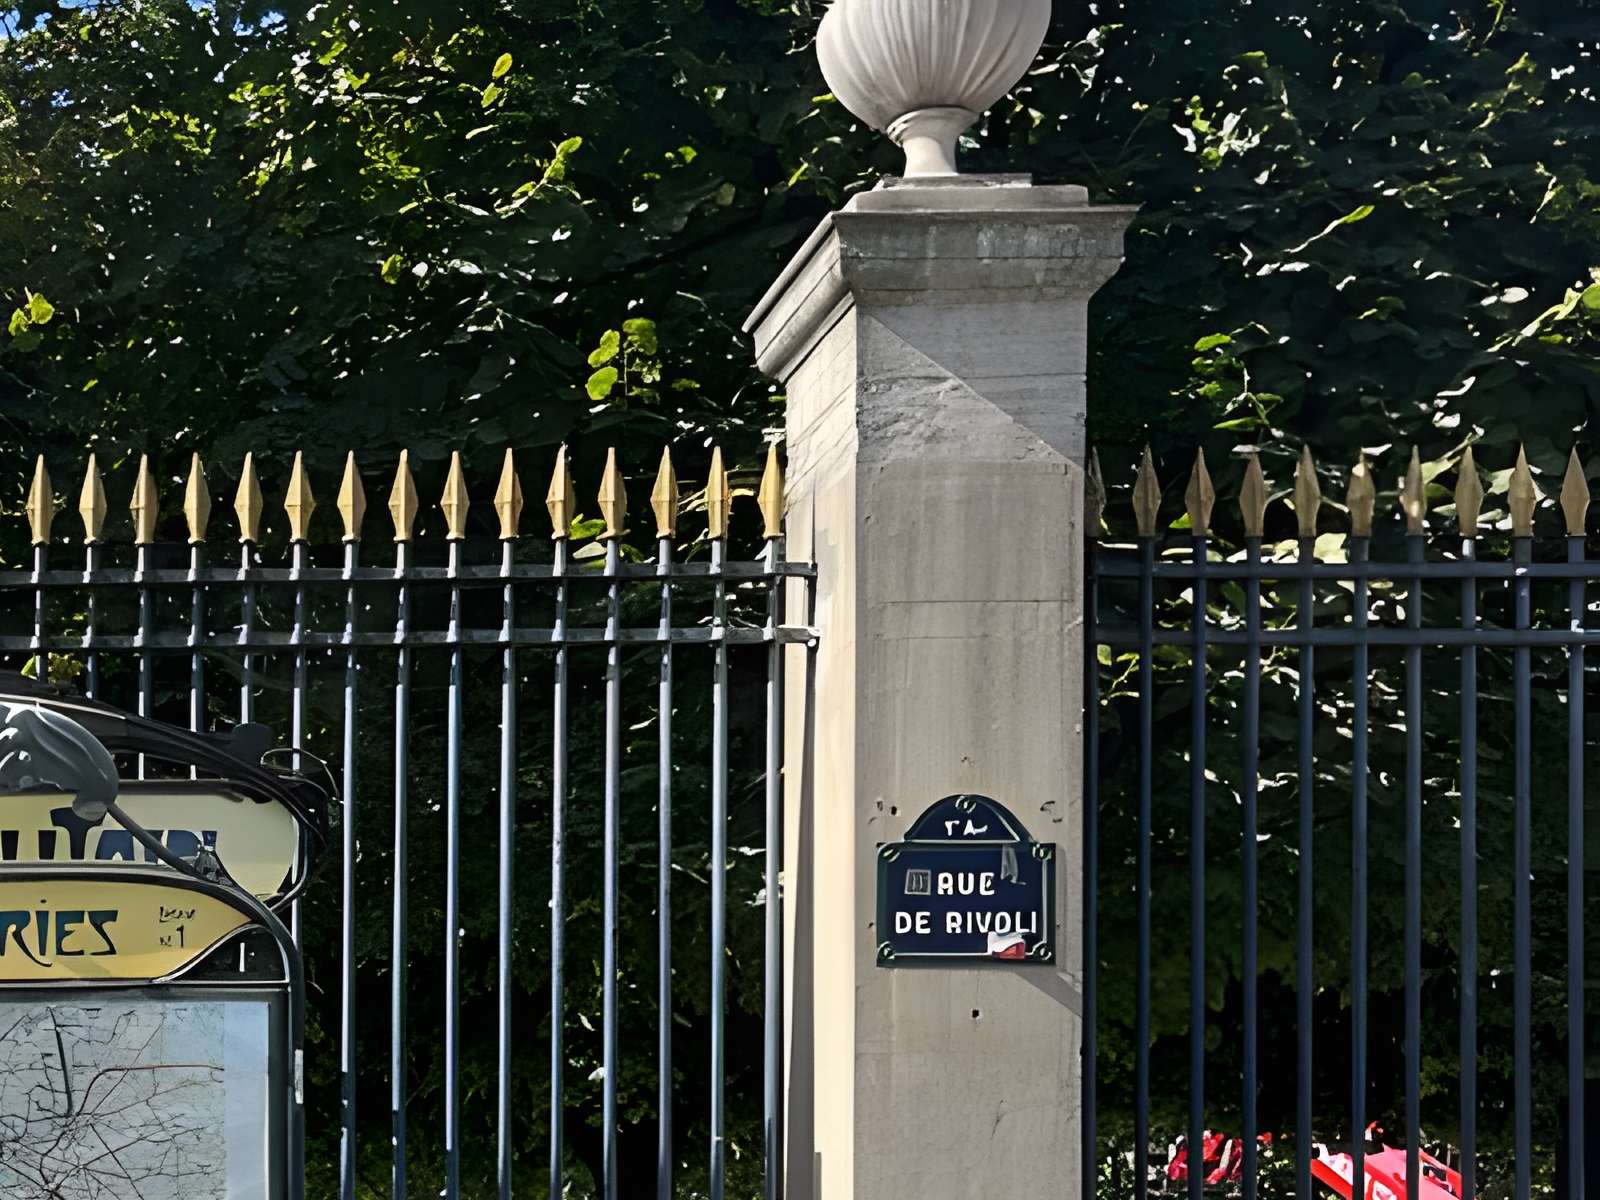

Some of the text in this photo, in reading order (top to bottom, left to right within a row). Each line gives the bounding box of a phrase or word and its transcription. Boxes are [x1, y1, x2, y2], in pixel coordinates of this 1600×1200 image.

[937, 872, 995, 895] RUE
[895, 911, 1037, 934] DE RIVOLI
